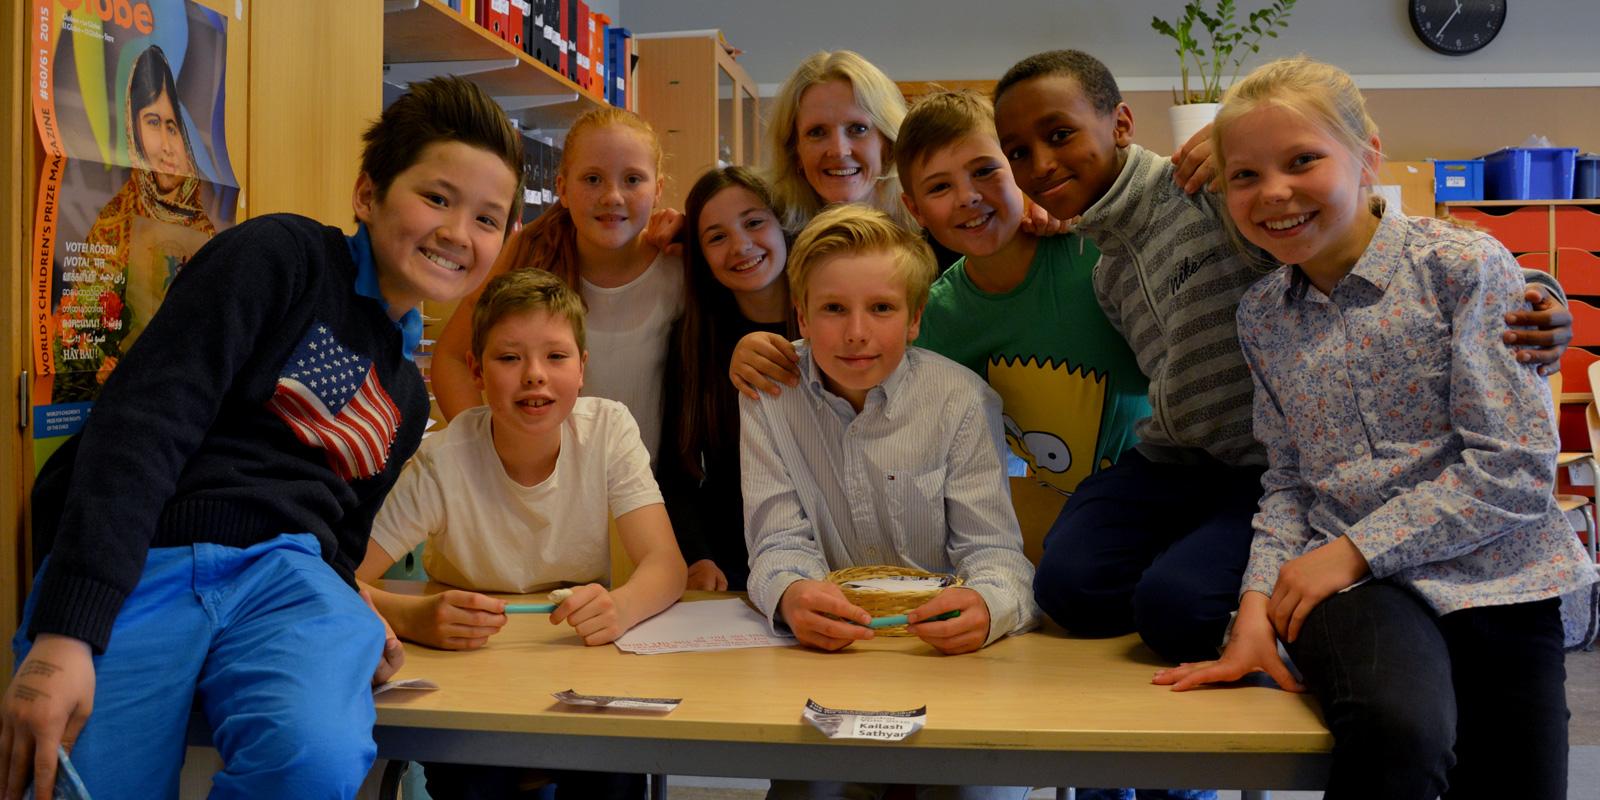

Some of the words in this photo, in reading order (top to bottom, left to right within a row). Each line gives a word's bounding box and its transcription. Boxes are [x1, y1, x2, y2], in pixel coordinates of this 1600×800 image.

[40, 6, 49, 41] 2015
[60, 0, 154, 35] obe
[39, 48, 49, 100] #60/61
[41, 108, 62, 180] MAGAZINE
[44, 185, 55, 222] PRIZE
[38, 226, 51, 310] CHILDREN'S
[65, 241, 89, 253] VOTE!
[39, 313, 50, 377] WORLD'S
